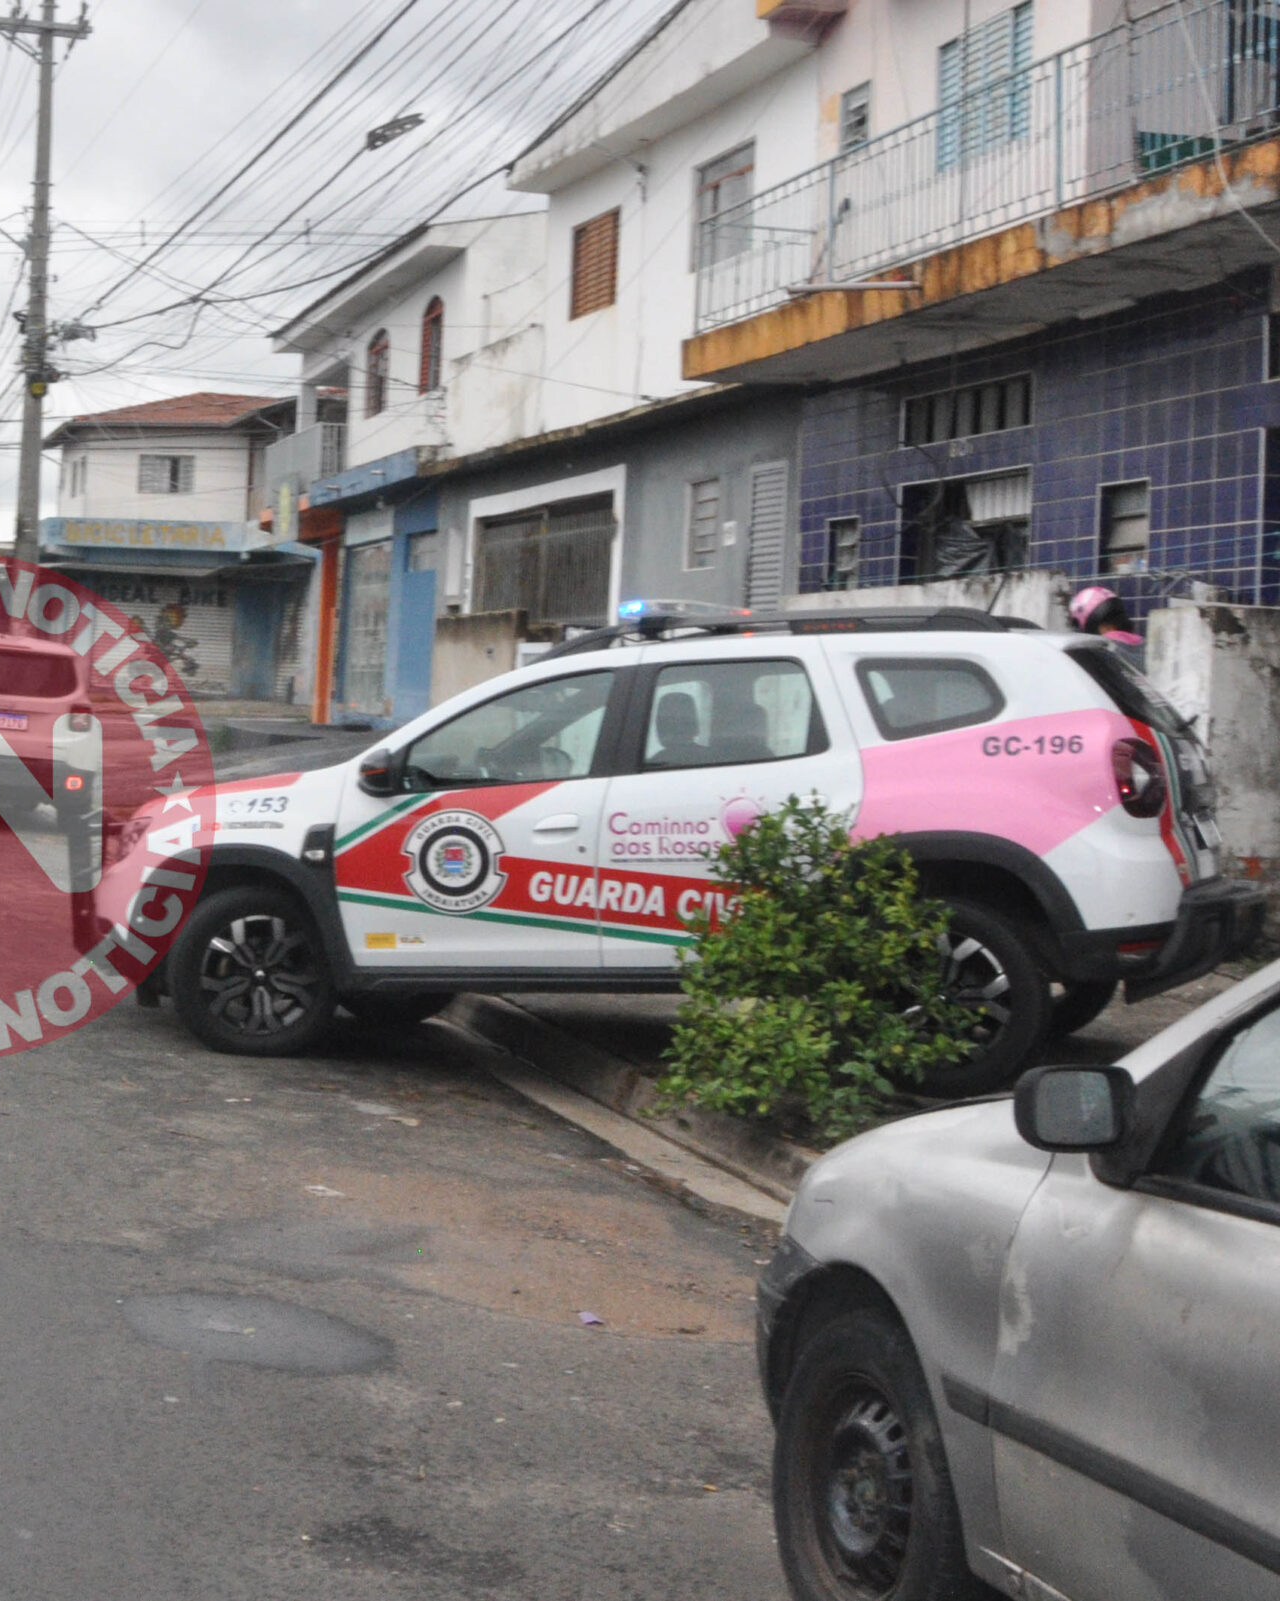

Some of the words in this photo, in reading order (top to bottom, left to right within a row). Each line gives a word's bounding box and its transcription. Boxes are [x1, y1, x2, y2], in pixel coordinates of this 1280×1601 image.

[64, 520, 227, 547] BICICLETARIA
[982, 734, 1084, 757] GC-196
[247, 796, 289, 813] 153
[416, 815, 461, 841] GUARDA
[465, 817, 495, 841] CIVIL
[528, 871, 666, 917] GUARDA
[677, 889, 744, 923] CIV
